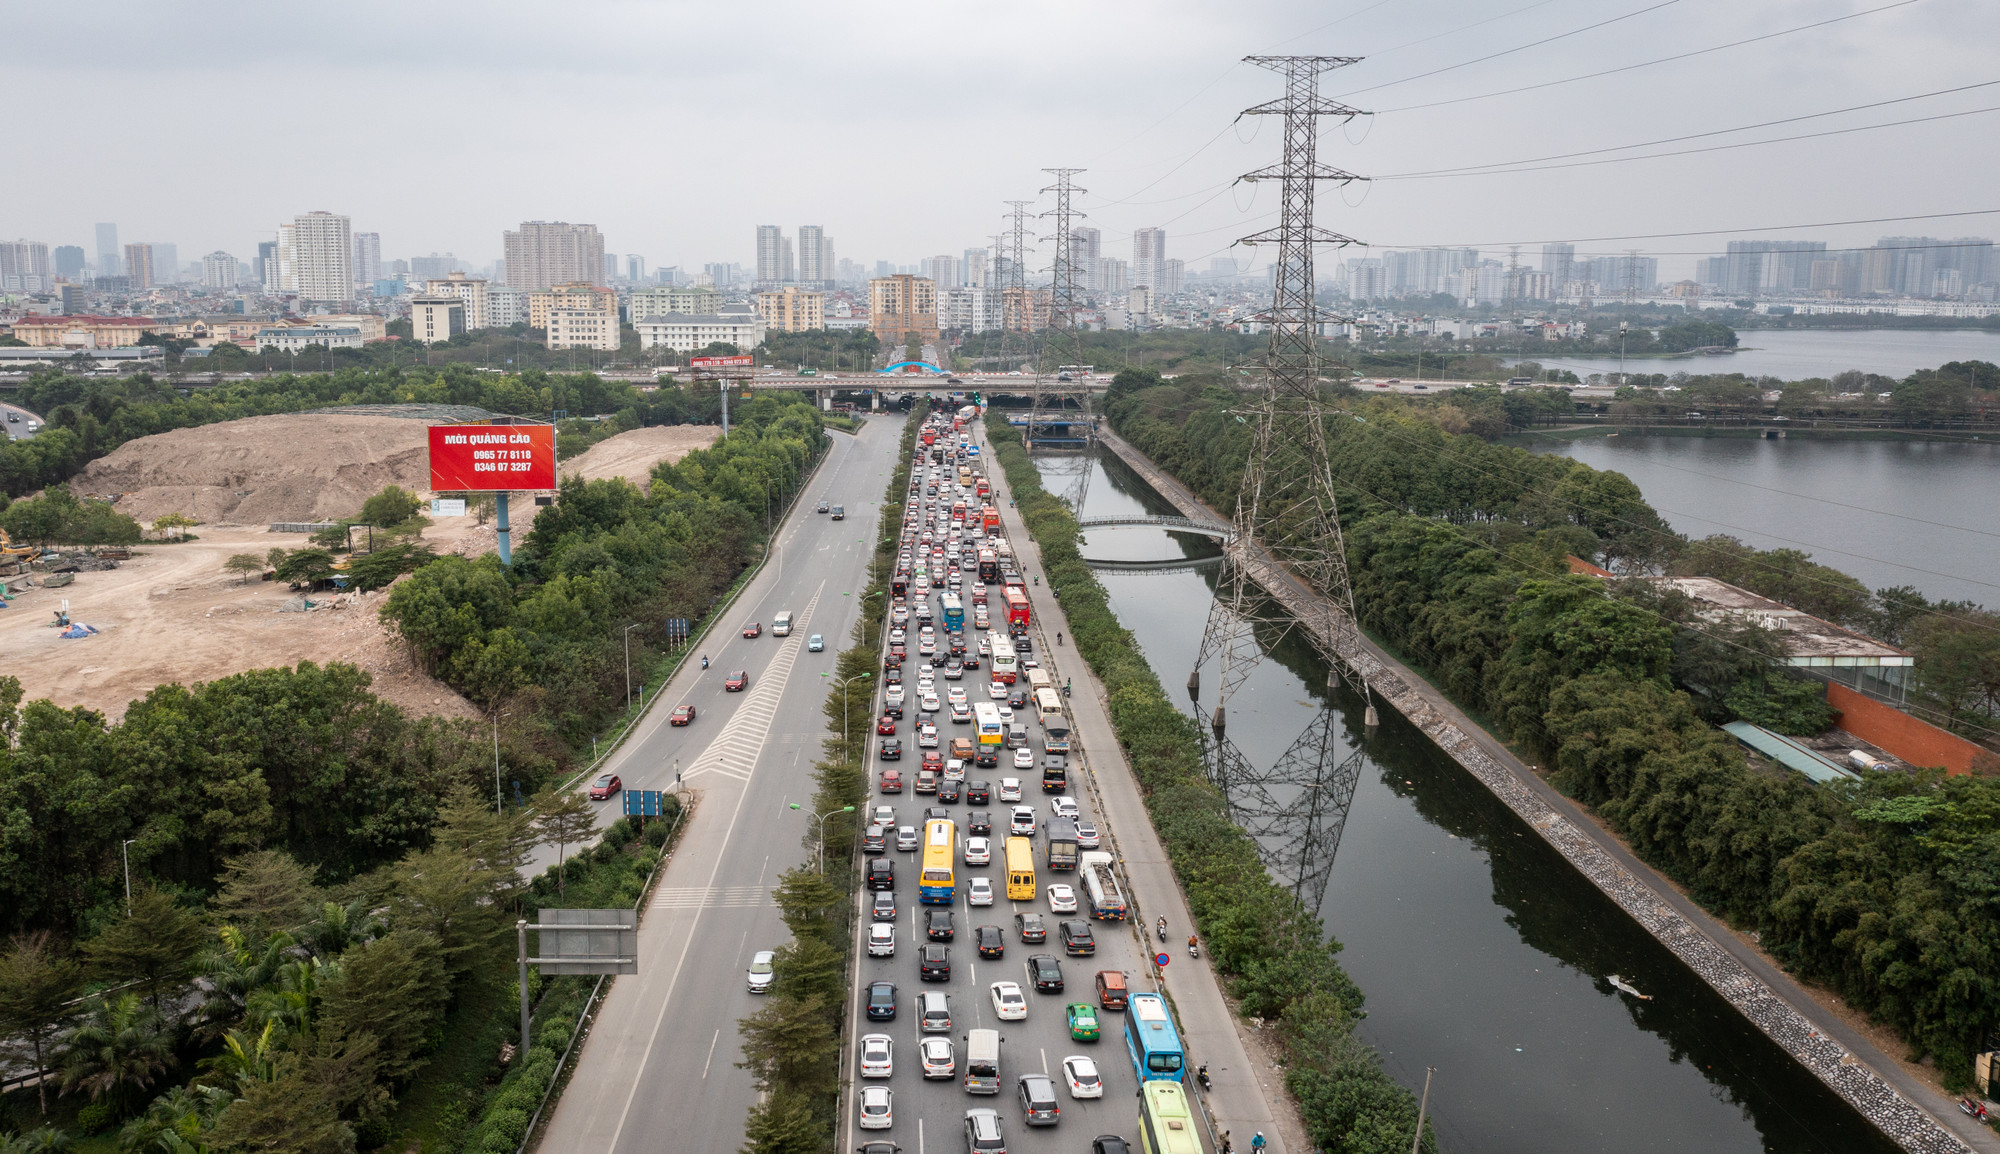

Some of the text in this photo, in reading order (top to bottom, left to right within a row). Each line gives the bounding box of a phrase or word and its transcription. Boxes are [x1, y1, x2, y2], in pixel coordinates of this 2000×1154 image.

[469, 433, 507, 445] QUẢNG
[509, 433, 530, 444] CÁO
[474, 450, 531, 459] 0965 77 8118
[474, 462, 532, 472] 0346 07 3287
